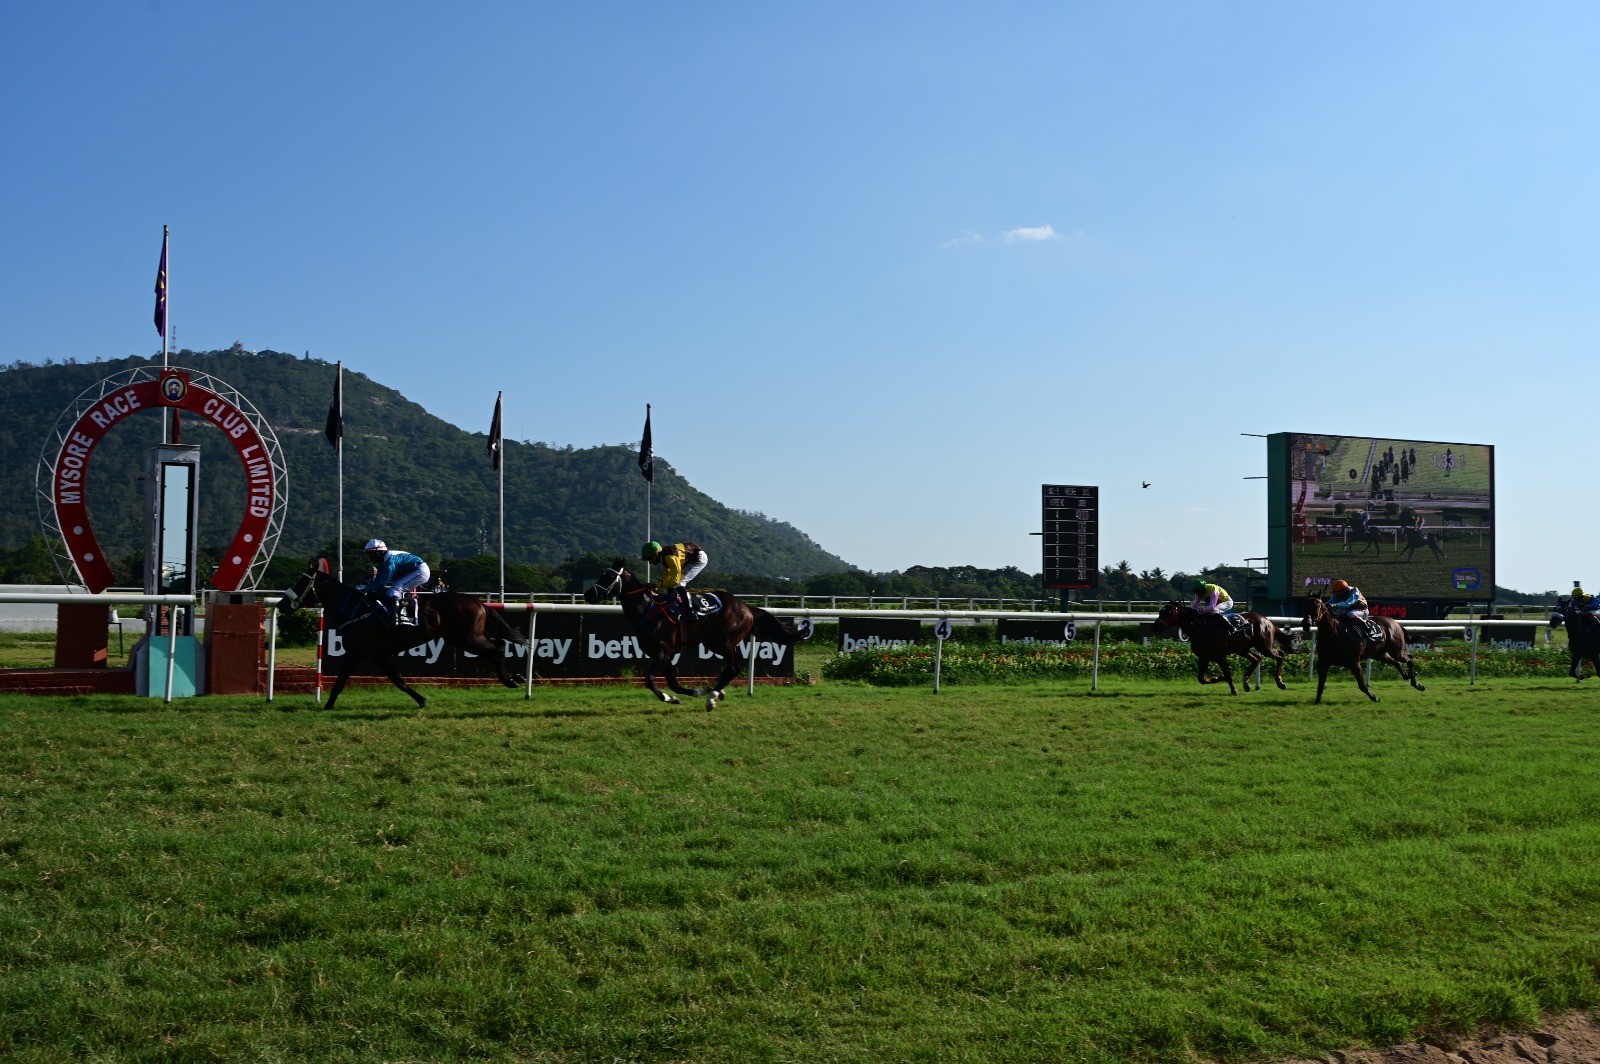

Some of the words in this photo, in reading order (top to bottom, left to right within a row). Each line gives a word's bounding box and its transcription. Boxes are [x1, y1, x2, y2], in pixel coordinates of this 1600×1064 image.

[60, 431, 94, 504] MYSORE
[90, 389, 142, 429] RACE
[203, 398, 249, 439] CLUB
[242, 444, 271, 518] LIMITED
[700, 598, 710, 607] 6
[1381, 604, 1407, 618] going
[937, 621, 948, 639] 4
[1067, 624, 1075, 639] 5
[1466, 629, 1471, 641] 9
